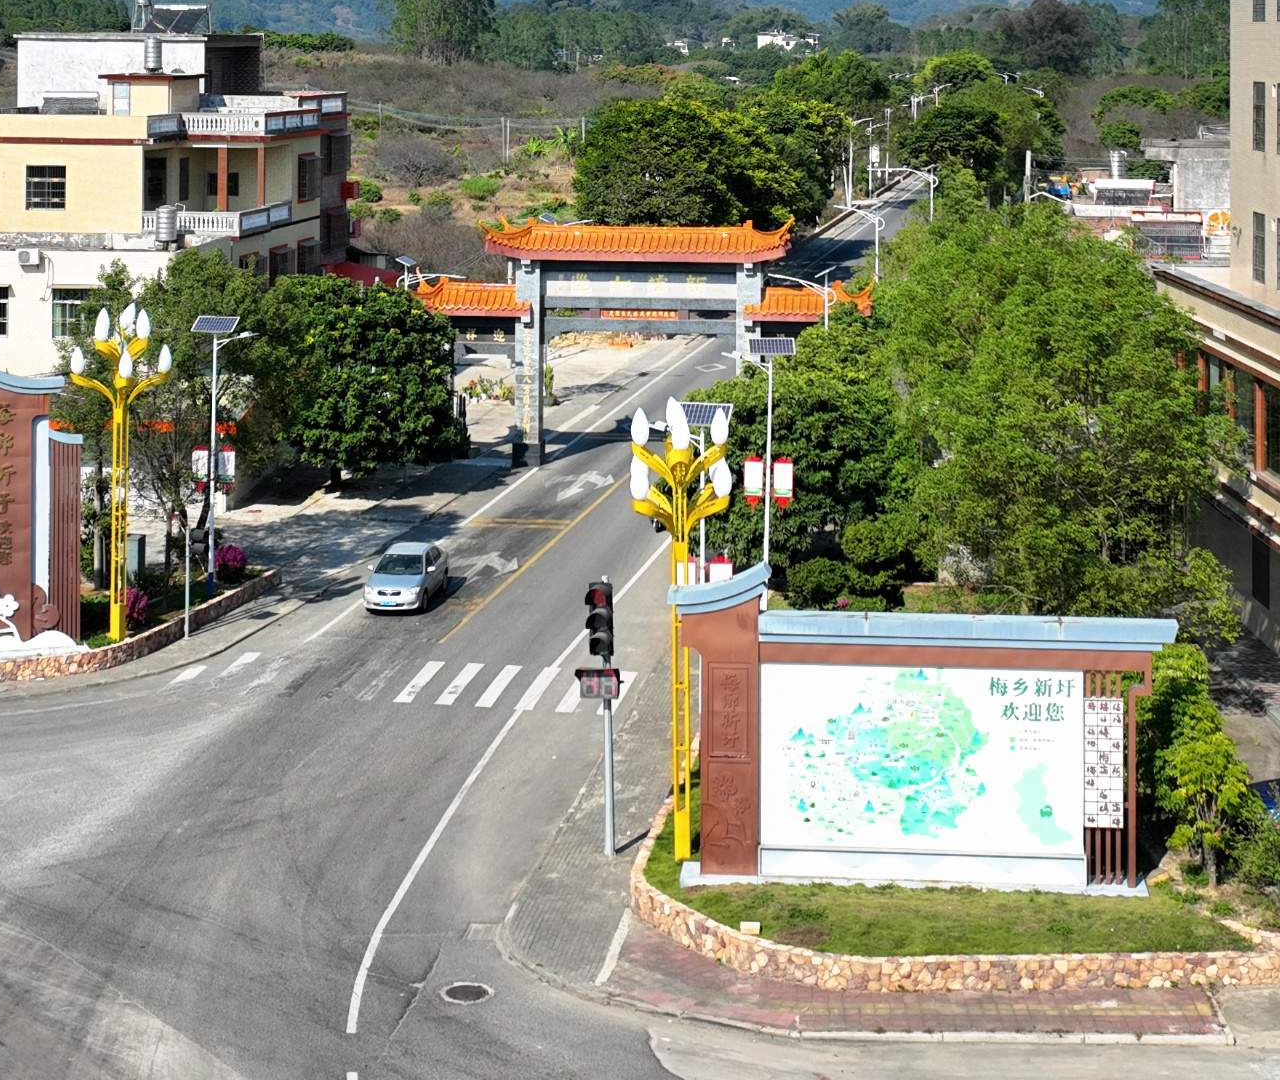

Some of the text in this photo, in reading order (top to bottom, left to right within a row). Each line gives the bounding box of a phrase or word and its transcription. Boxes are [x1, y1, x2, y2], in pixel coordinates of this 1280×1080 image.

[989, 677, 1075, 697] 梅乡新圩
[1001, 702, 1064, 721] 欢迎您
